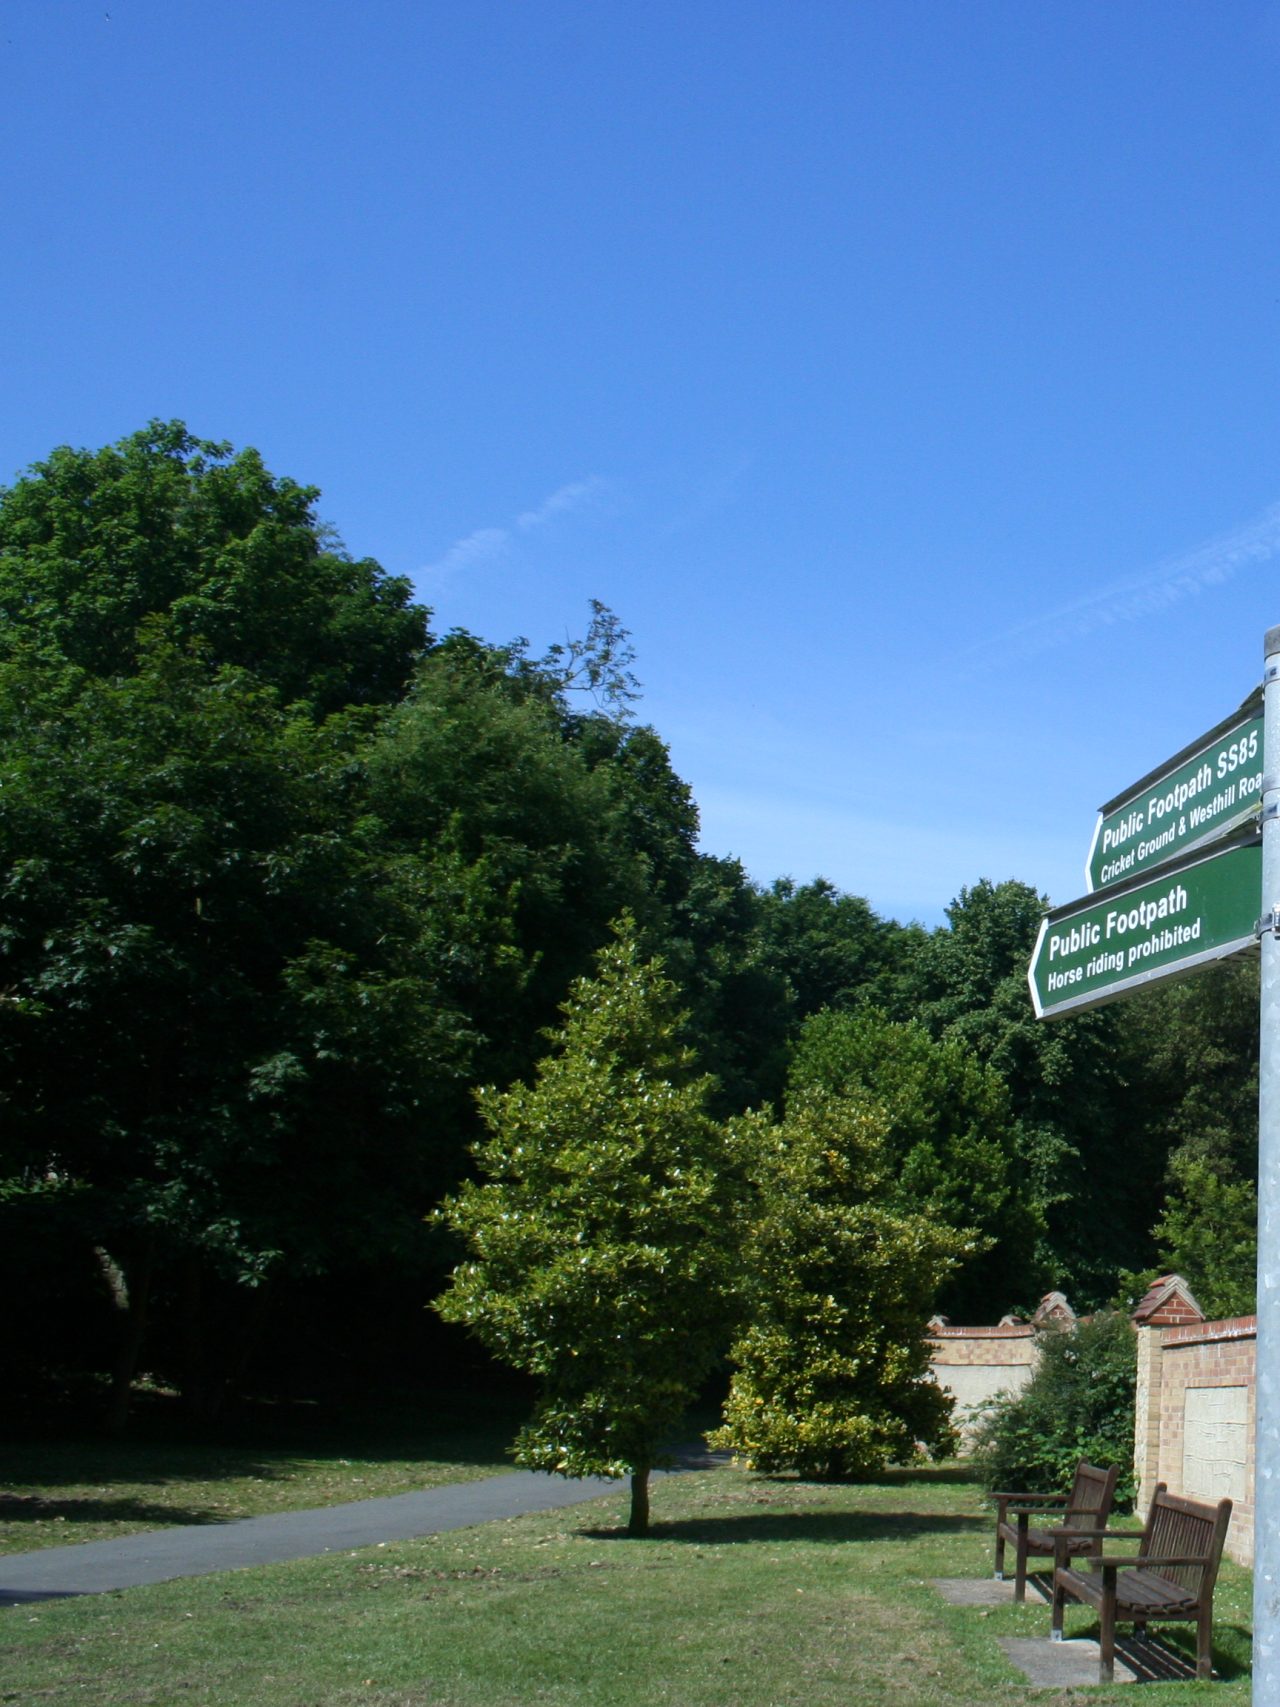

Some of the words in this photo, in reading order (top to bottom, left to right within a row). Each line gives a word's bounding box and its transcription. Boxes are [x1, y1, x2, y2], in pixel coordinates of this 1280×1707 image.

[1101, 851, 1134, 883] Cricket
[1137, 828, 1175, 860] Ground
[1178, 816, 1186, 835] &
[1190, 784, 1235, 827] Westhill
[1239, 772, 1263, 799] Roa
[1102, 812, 1143, 853] Public
[1148, 764, 1211, 824] Footpath
[1217, 730, 1257, 778] SS85
[1048, 967, 1082, 991] Horse
[1087, 949, 1123, 979] riding
[1128, 917, 1200, 965] prohibited
[1050, 922, 1100, 960] Public
[1106, 885, 1187, 938] Footpath
